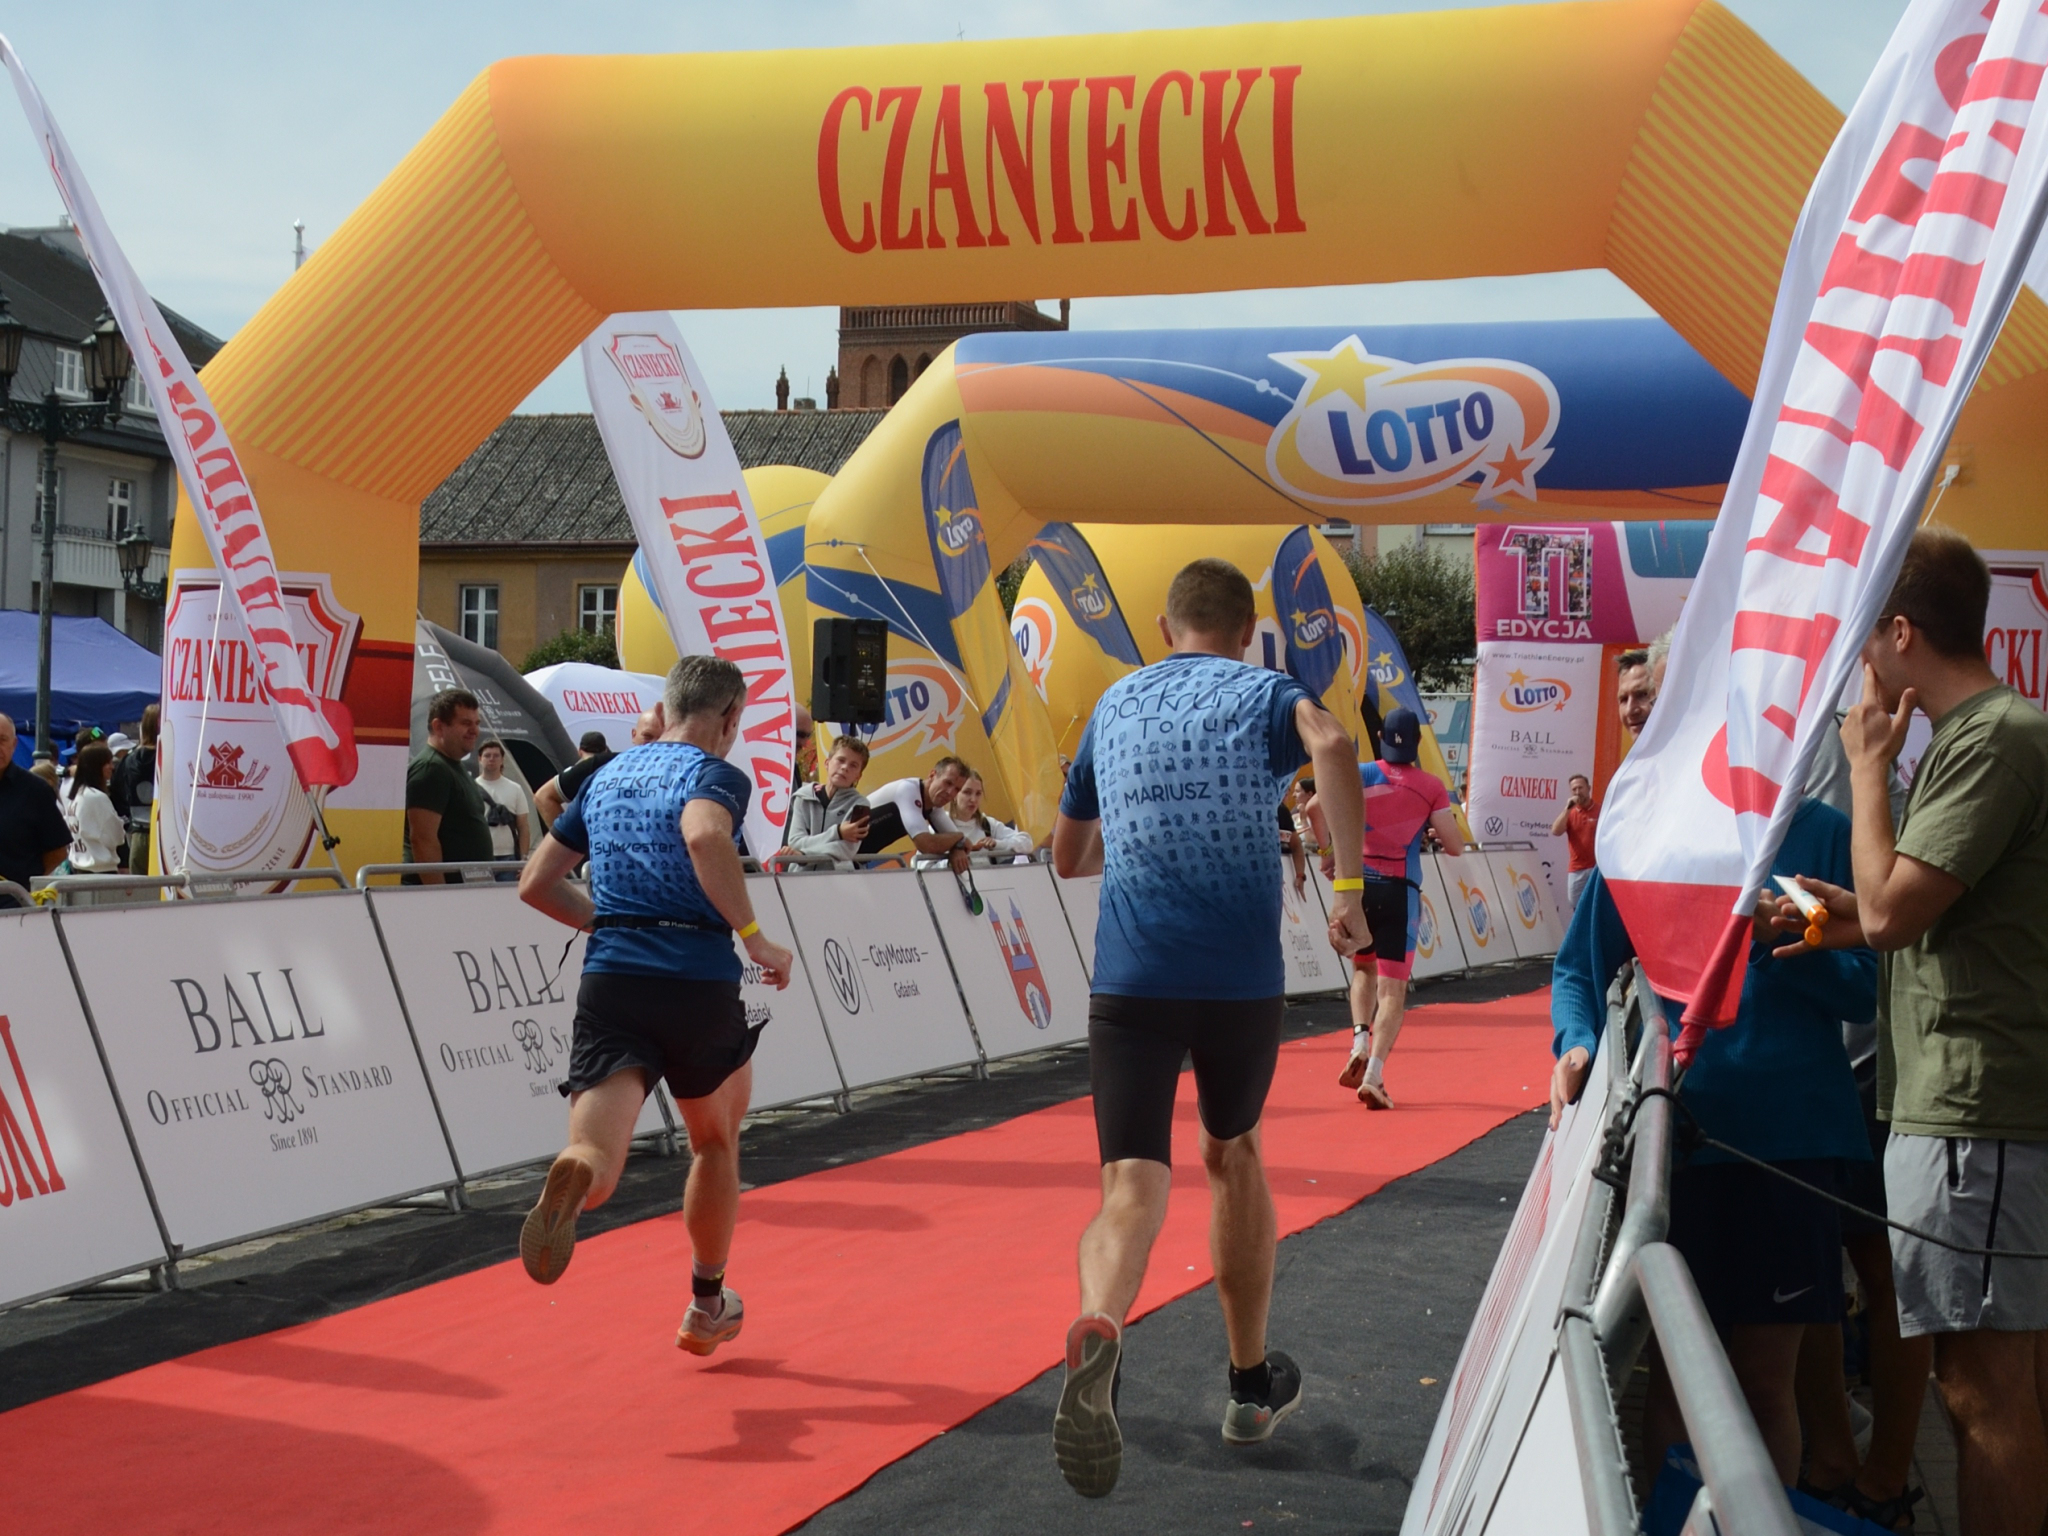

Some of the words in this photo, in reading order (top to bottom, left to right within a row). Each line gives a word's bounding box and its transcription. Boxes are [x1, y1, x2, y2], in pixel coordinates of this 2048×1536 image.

[817, 65, 1307, 254] CZANIECKI
[1327, 391, 1494, 475] LOTTO
[1497, 619, 1592, 639] EDYCJA
[563, 690, 642, 714] CZANIECKI
[1514, 686, 1557, 705] LOTTO
[1510, 730, 1556, 744] BALL
[1124, 782, 1212, 808] MARIUSZ
[1500, 776, 1558, 800] CZANIECKI
[452, 944, 566, 1014] BALL
[894, 982, 921, 999] Gdańsk
[170, 968, 325, 1054] BALL
[270, 1132, 296, 1152] Since
[298, 1126, 319, 1146] 1891
